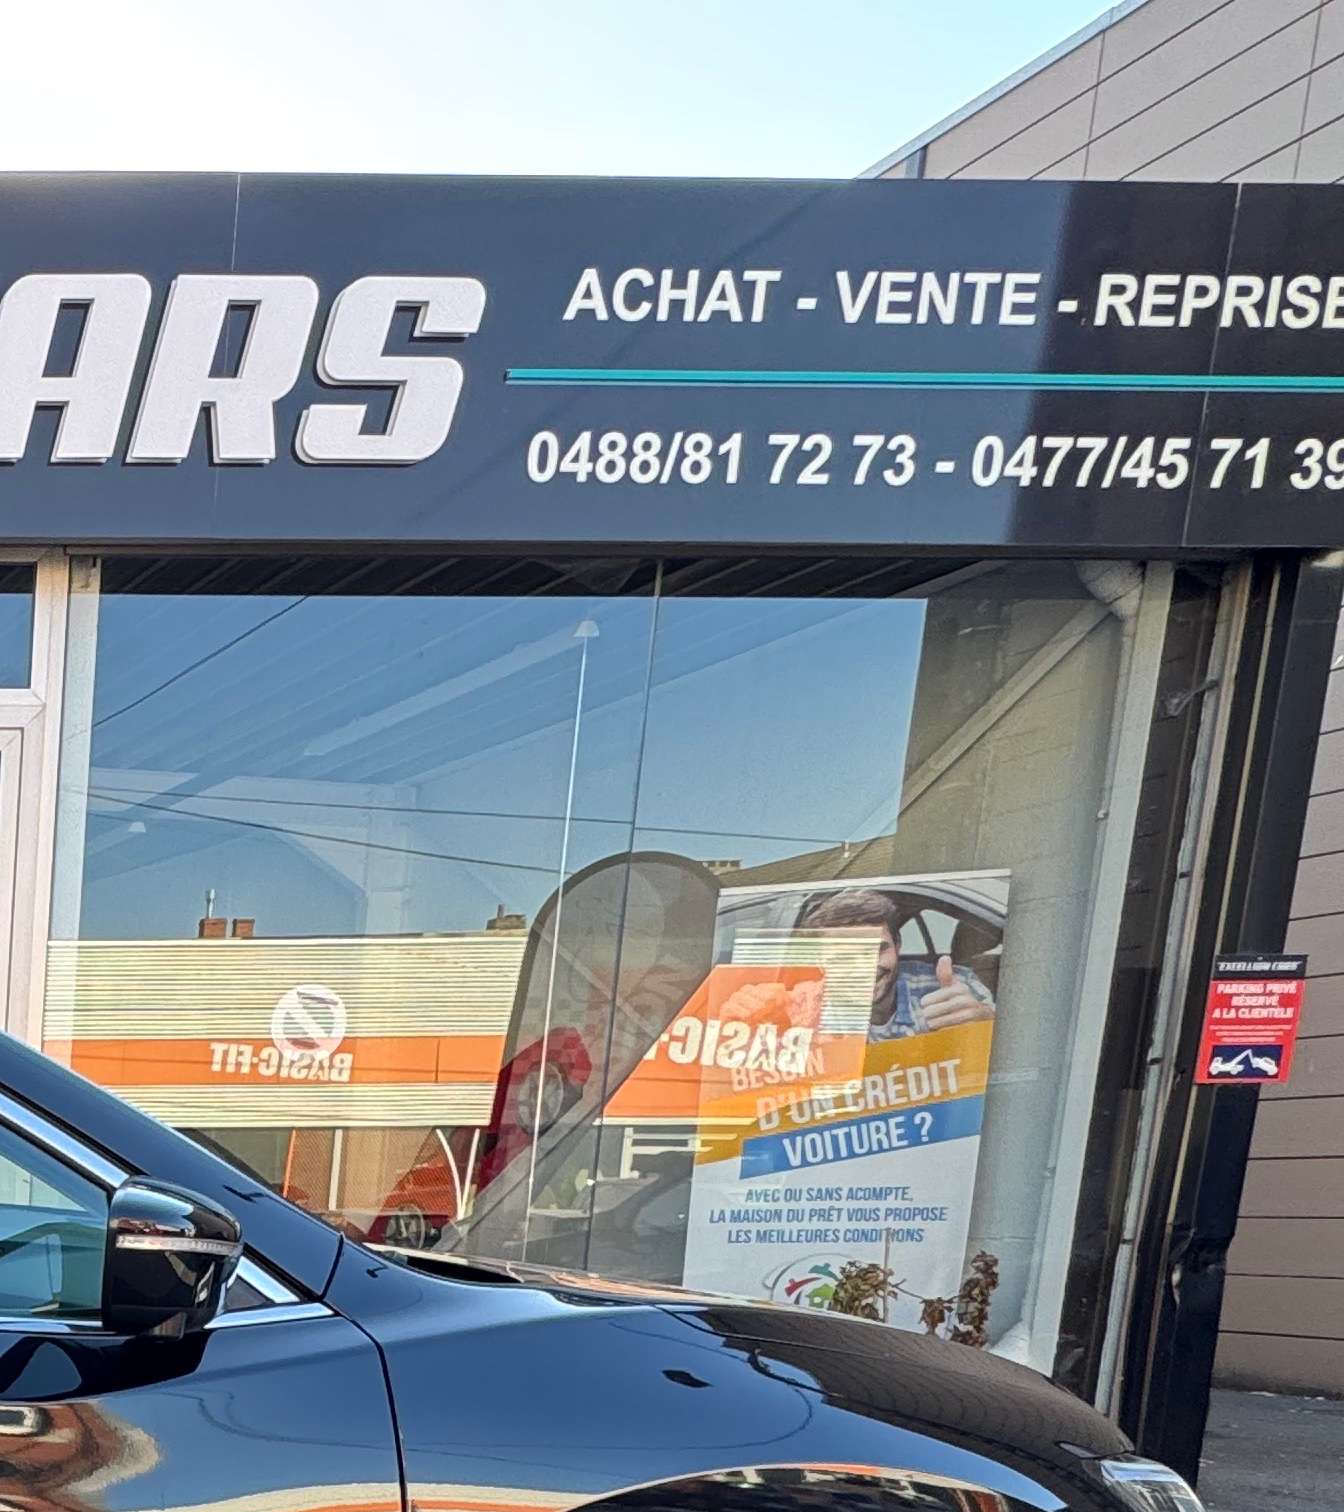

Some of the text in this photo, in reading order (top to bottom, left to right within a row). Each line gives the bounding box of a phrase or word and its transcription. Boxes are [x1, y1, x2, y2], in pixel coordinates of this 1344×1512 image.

[563, 267, 782, 324] ACHAT
[835, 270, 1042, 327] VENTE
[1093, 273, 1344, 329] REPRISE
[525, 430, 744, 486] 0488/81
[766, 433, 832, 487] 72
[851, 434, 917, 488] 73
[971, 435, 1193, 491] 0477/45
[1209, 437, 1271, 490] 71
[1289, 437, 1344, 491] 39
[845, 1059, 961, 1113] CRÉDIT
[782, 1112, 933, 1168] VOITURE ?
[710, 1205, 949, 1223] LA MAISON DU PRÊT VOUS PROPOSE
[745, 1188, 780, 1203] AVEC
[784, 1188, 802, 1202] OU
[805, 1187, 842, 1202] SANS
[727, 1229, 752, 1244] LES
[755, 1228, 840, 1244] MEILLEURES
